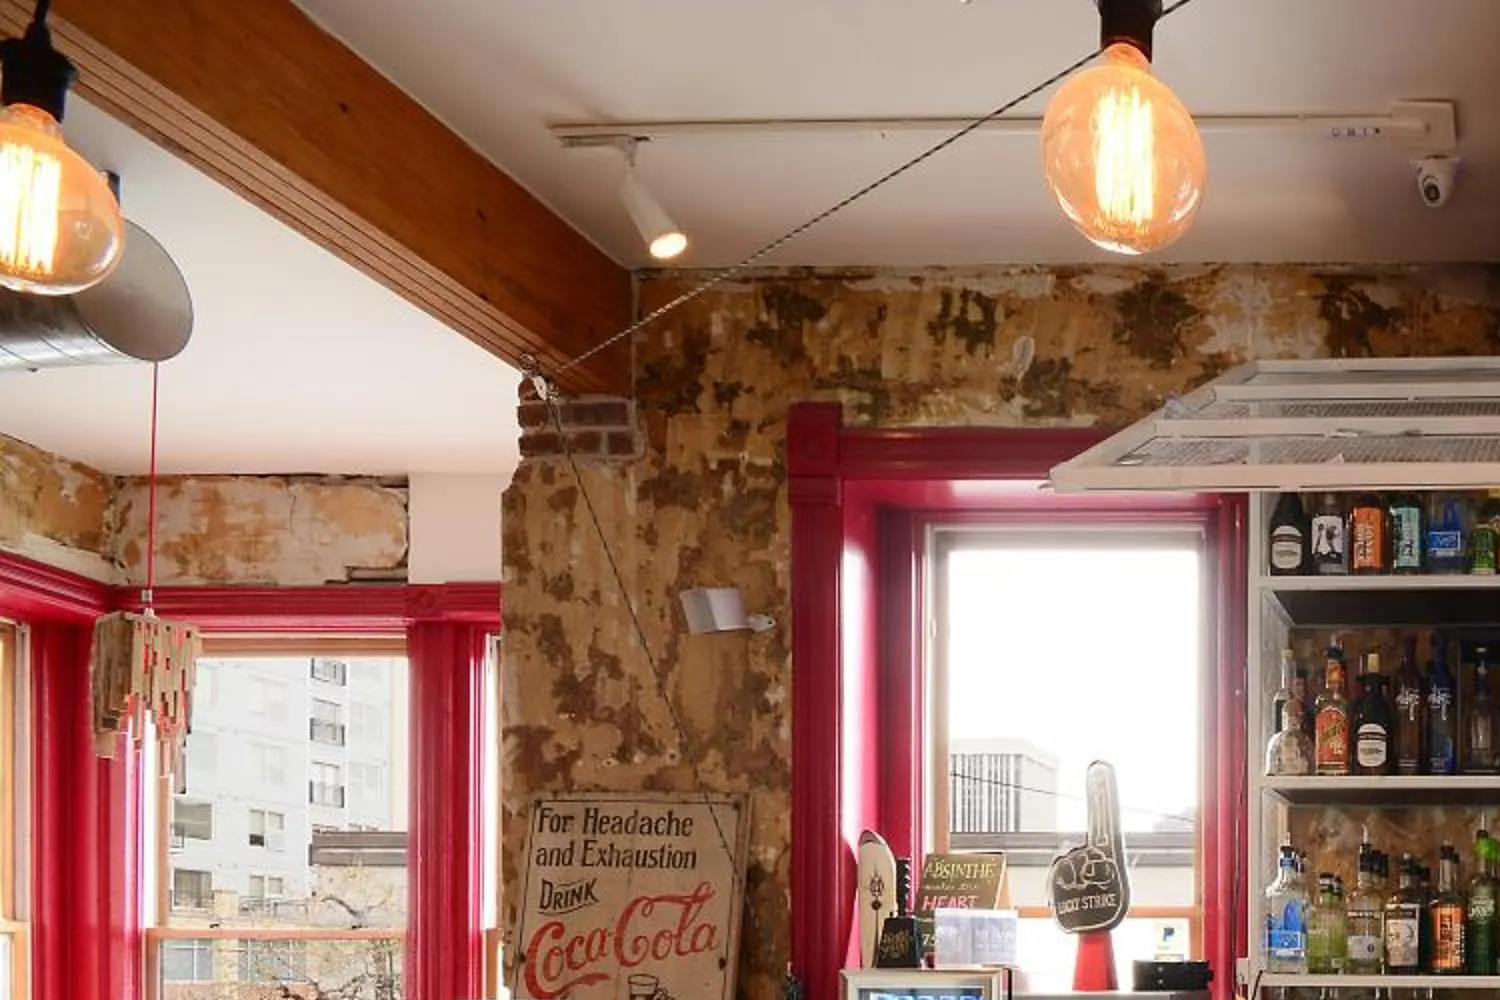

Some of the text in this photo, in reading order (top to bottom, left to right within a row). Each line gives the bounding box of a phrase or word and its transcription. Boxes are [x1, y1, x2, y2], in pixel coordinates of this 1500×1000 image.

[538, 806, 694, 837] For Headache
[535, 840, 697, 870] and Exhaustion
[923, 858, 997, 879] ABSINTHE
[539, 878, 599, 911] DRINK
[922, 895, 978, 911] HEART
[1081, 894, 1118, 909] STRIKE
